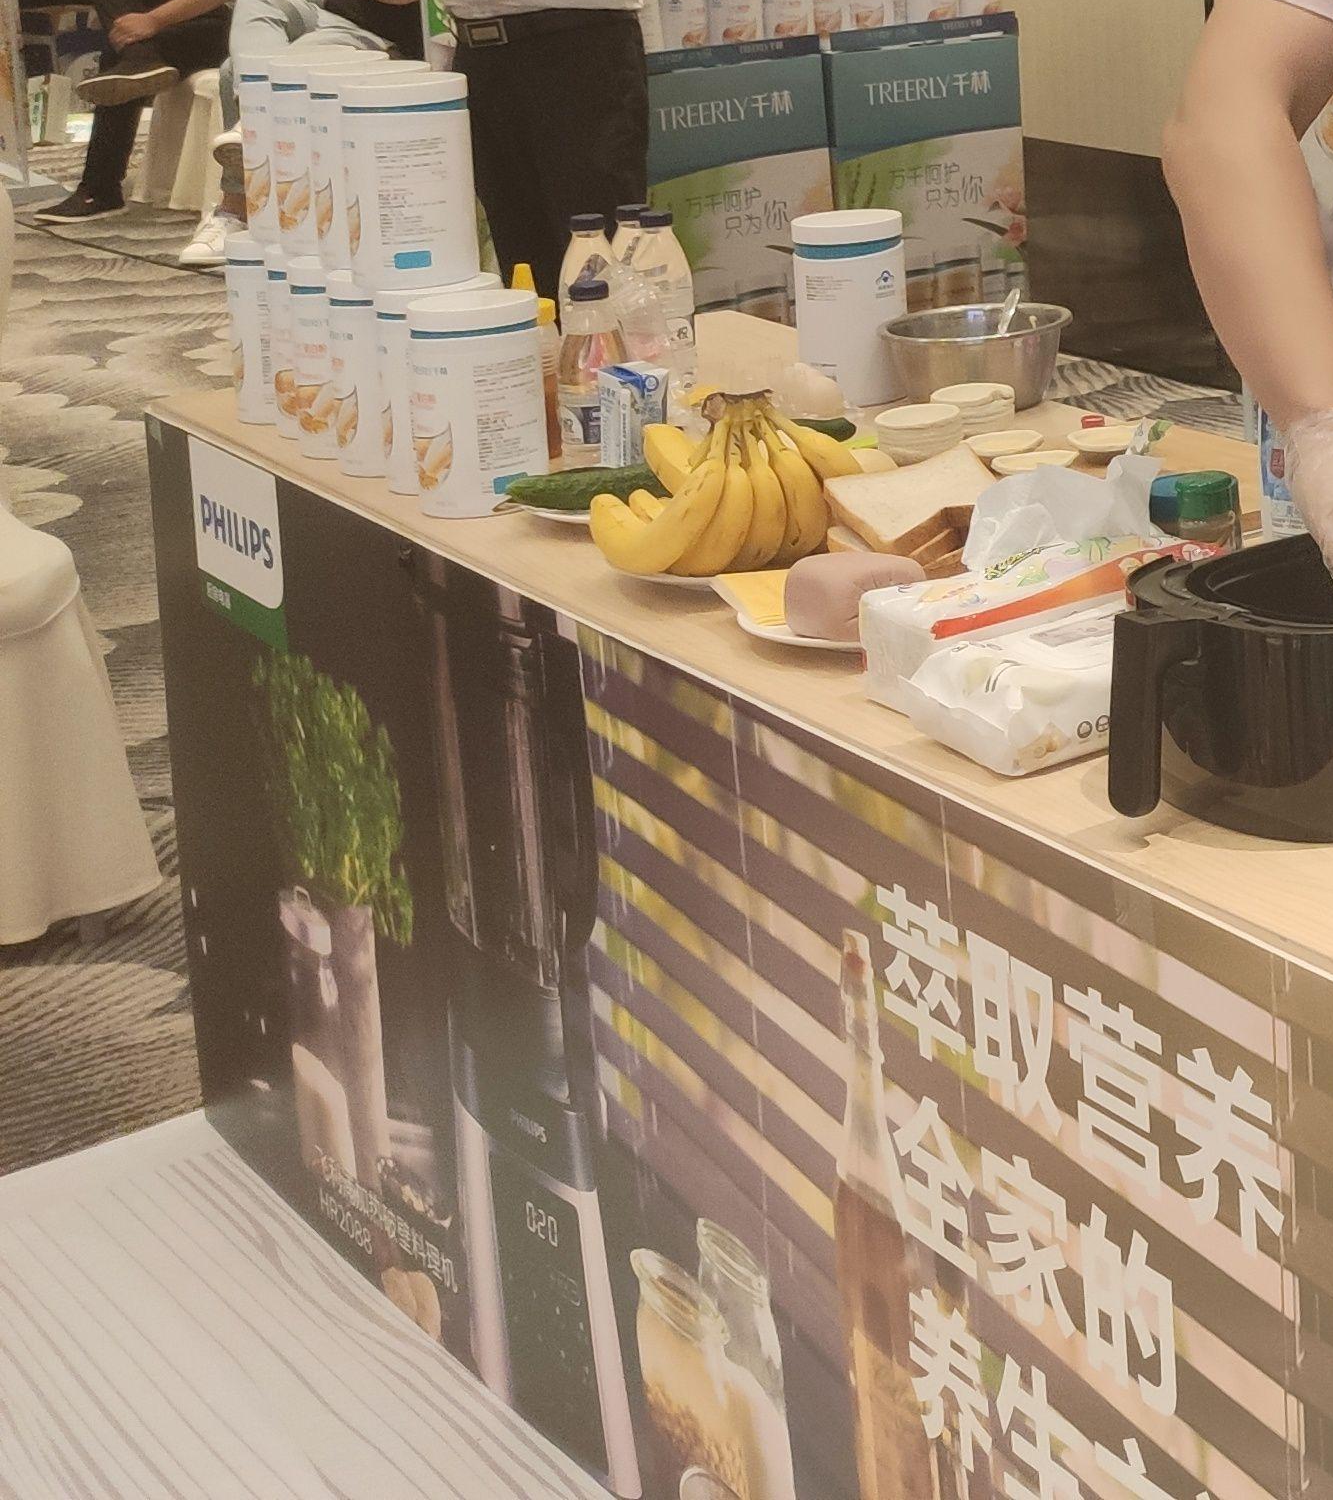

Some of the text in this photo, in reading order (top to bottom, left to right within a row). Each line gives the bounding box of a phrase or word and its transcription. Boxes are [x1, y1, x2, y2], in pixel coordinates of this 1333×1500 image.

[864, 69, 991, 106] TREERLY 千林
[658, 90, 794, 132] TREERLY 千林
[889, 161, 960, 193] 万千呵护
[925, 174, 985, 211] 只为你
[685, 187, 762, 219] 万千呵护
[725, 199, 790, 239] 只为你
[200, 494, 274, 570] PHILIPS
[875, 882, 1285, 1258] 萃取营养
[892, 1095, 1178, 1416] 全家的
